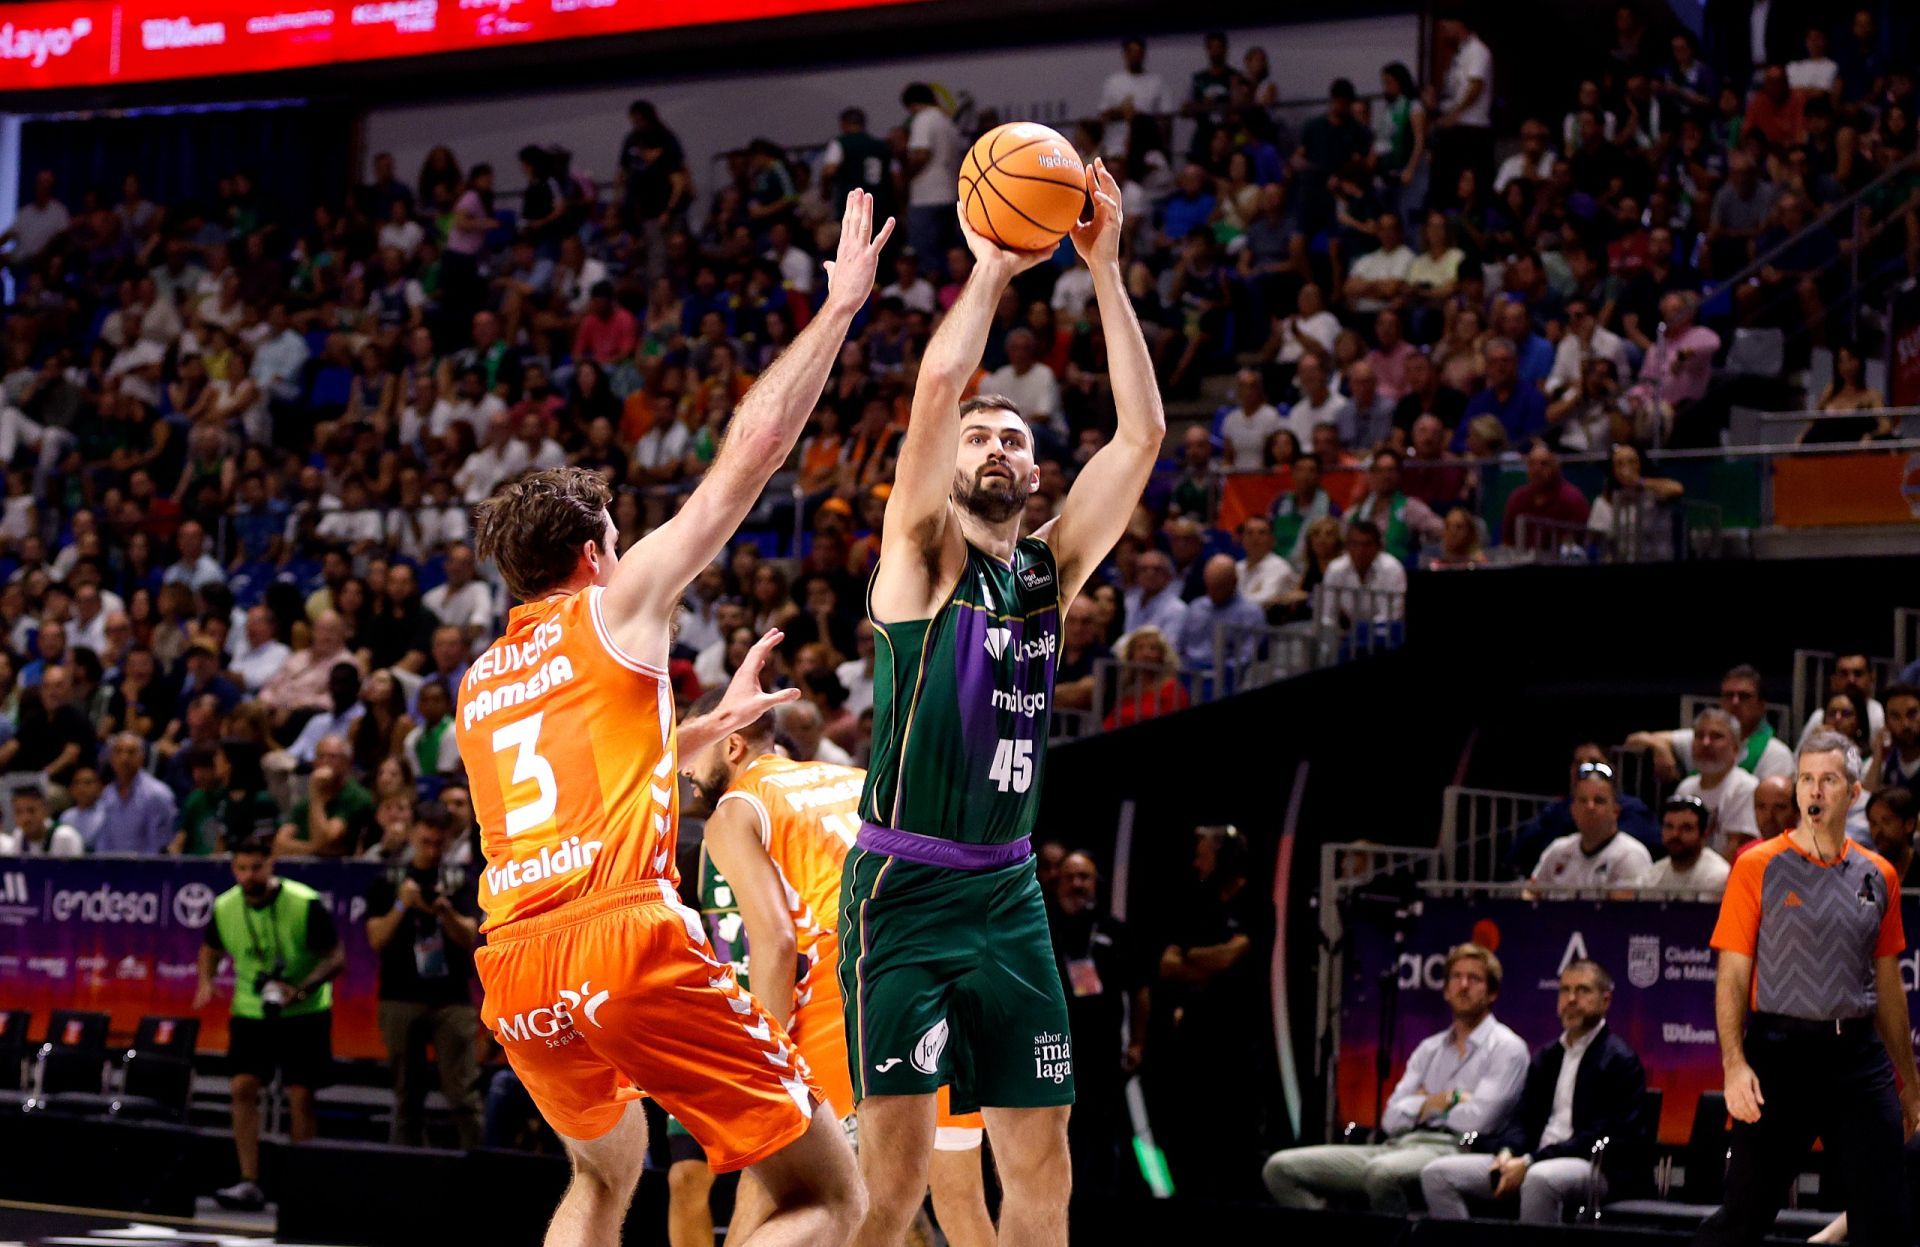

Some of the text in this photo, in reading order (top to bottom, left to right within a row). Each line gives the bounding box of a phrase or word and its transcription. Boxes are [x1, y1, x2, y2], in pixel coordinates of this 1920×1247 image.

[0, 22, 72, 68] layo
[467, 613, 562, 692] REUVERS
[1013, 630, 1055, 662] Uncaja
[463, 655, 573, 732] PAMESA
[991, 684, 1045, 718] málga
[492, 710, 558, 838] 3
[989, 738, 1033, 793] 45
[52, 881, 159, 924] endesa
[1397, 946, 1456, 991] ac
[1664, 945, 1711, 964] Ciudad
[1664, 964, 1682, 981] de
[497, 1001, 574, 1041] MGS
[1034, 1031, 1062, 1045] sabor
[1662, 1022, 1716, 1044] Wilson
[1034, 1035, 1071, 1061] a má
[1035, 1057, 1072, 1084] laga
